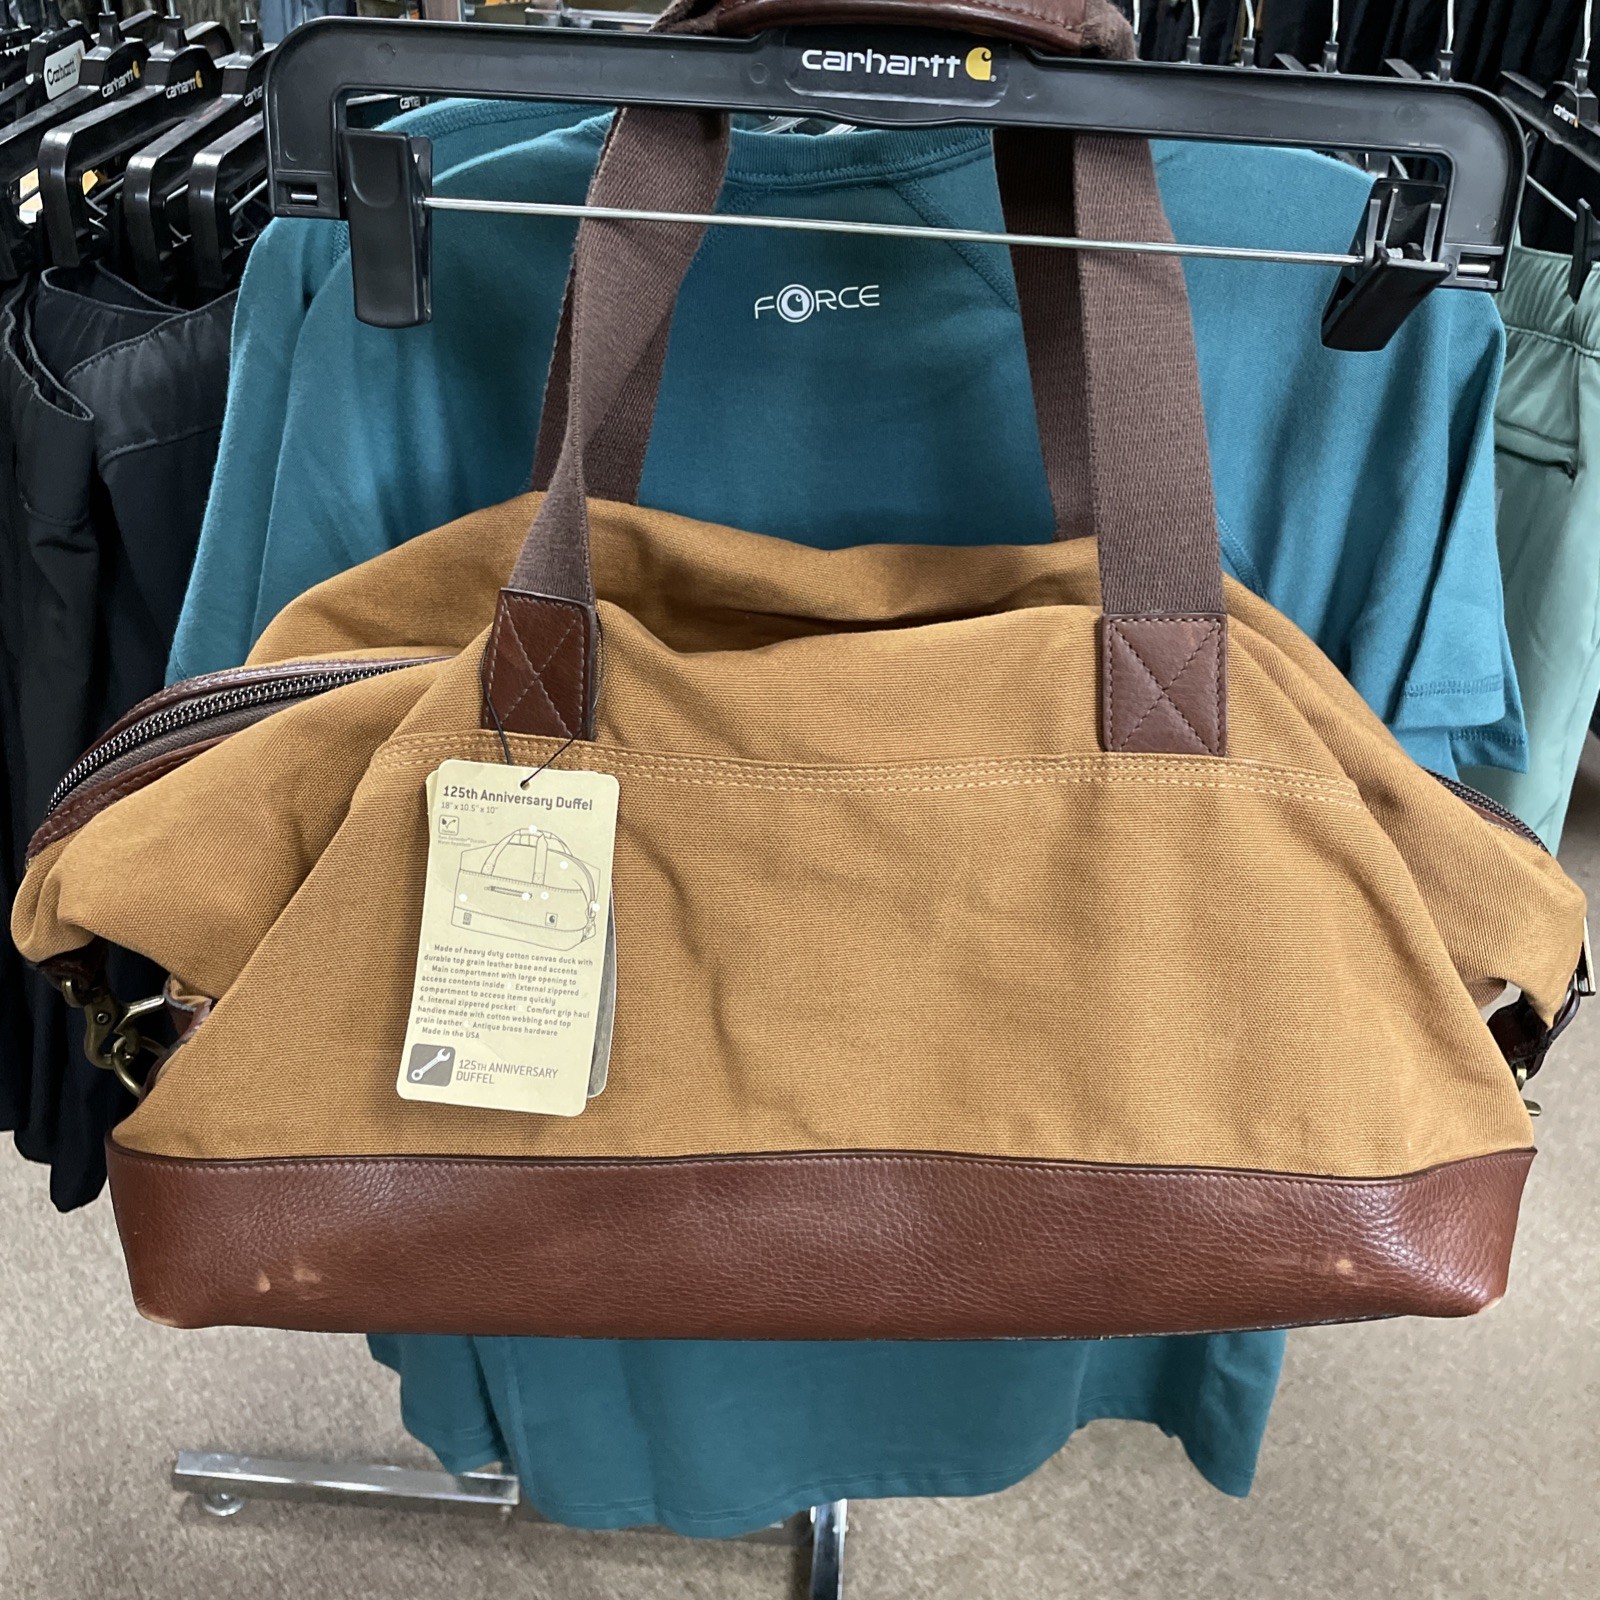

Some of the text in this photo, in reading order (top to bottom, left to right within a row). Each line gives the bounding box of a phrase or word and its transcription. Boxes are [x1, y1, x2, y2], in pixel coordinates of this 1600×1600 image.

[801, 48, 961, 79] carhartt
[754, 283, 880, 323] FORCE
[442, 785, 593, 811] 125th Anniversary Duffel
[424, 954, 451, 963] durable
[453, 957, 465, 965] top
[487, 960, 513, 969] leather
[434, 944, 453, 952] Made
[463, 948, 486, 958] heavy
[487, 950, 504, 959] duty
[506, 952, 529, 960] cotton
[577, 958, 593, 966] with
[432, 965, 448, 973] Main
[450, 967, 499, 978] compartment
[501, 972, 516, 980] with
[518, 974, 536, 983] large
[538, 976, 567, 986] opening
[420, 986, 469, 996] compartment
[480, 992, 505, 1000] access
[507, 993, 527, 1002] items
[529, 996, 556, 1006] quickly
[448, 977, 480, 986] contents
[482, 981, 505, 989] inside
[547, 987, 579, 996] zippered
[428, 996, 456, 1005] Internal
[457, 1000, 489, 1009] zippered
[491, 1002, 516, 1011] pocket
[526, 1005, 556, 1014] Comfort
[557, 1010, 572, 1018] grip
[415, 1016, 435, 1024] grain
[436, 1018, 463, 1026] leather
[473, 1022, 500, 1031] Antique
[524, 1027, 558, 1036] hardware
[448, 1009, 468, 1017] made
[469, 1010, 485, 1018] with
[486, 1012, 510, 1021] cotton
[512, 1015, 542, 1026] webbing
[559, 1020, 571, 1028] top
[422, 1026, 480, 1039] Made in the USA
[456, 1071, 495, 1084] DUFFEL
[459, 1059, 558, 1079] 125TH ANNIVERSARY
